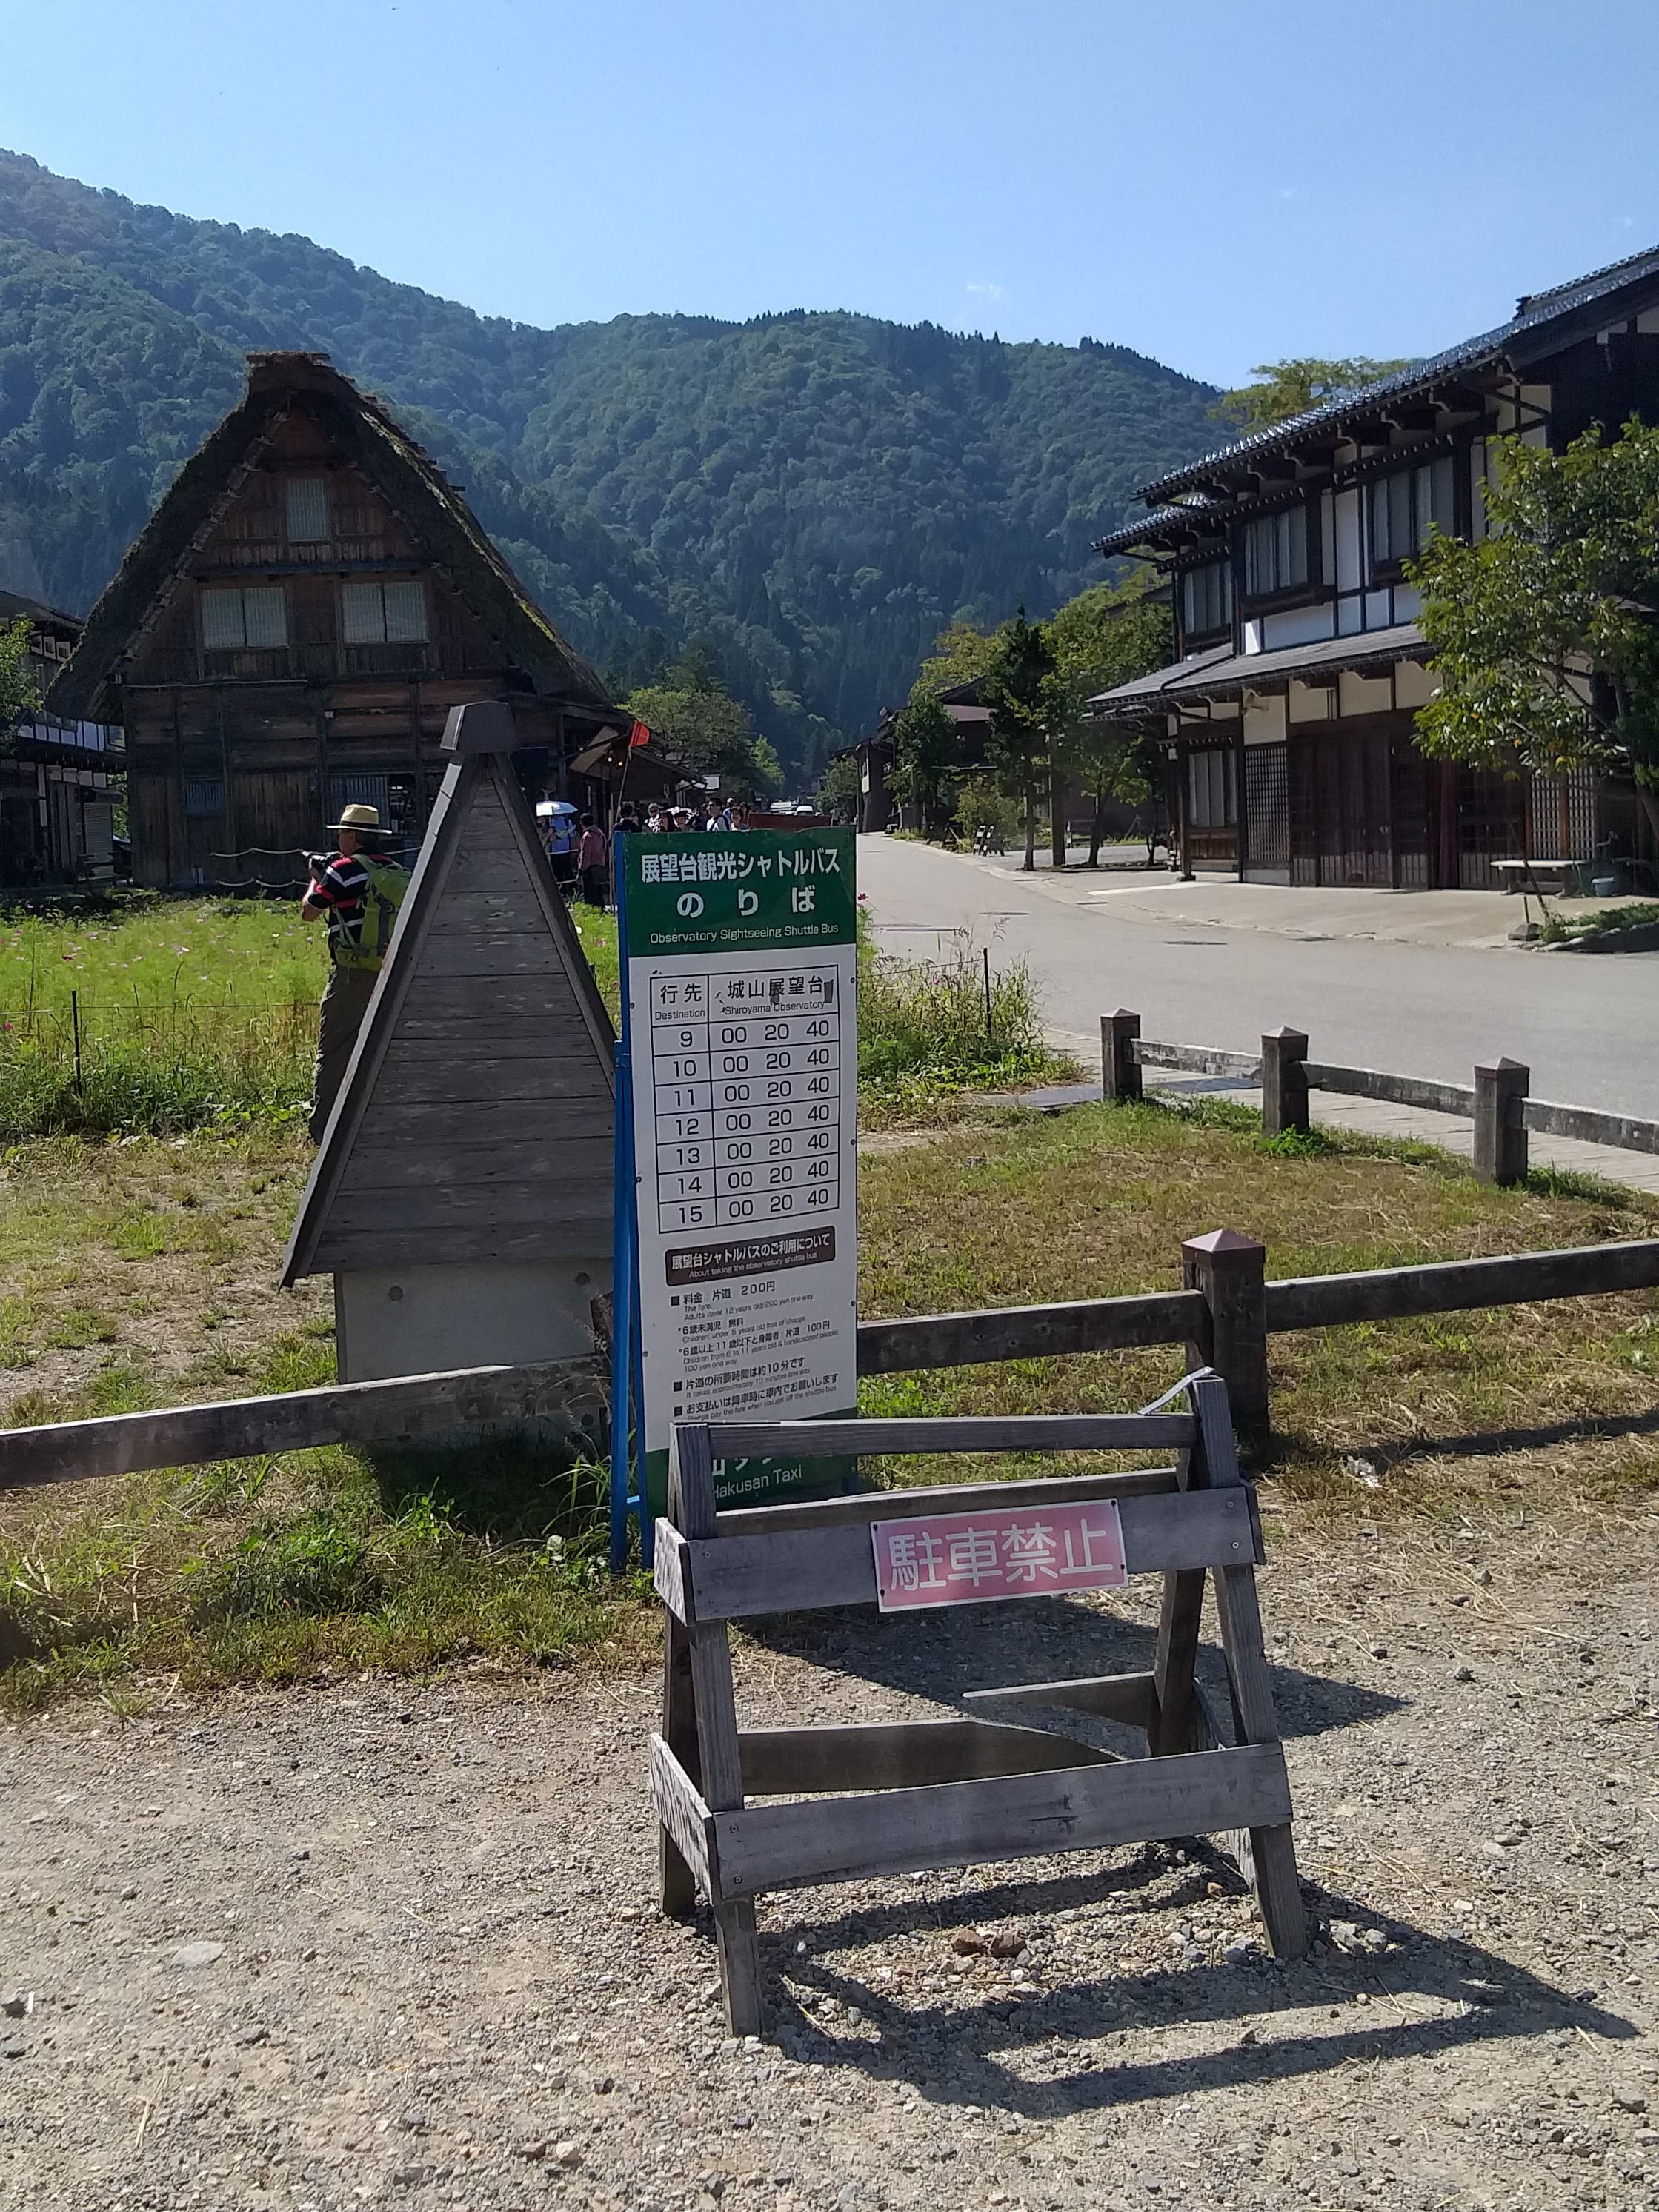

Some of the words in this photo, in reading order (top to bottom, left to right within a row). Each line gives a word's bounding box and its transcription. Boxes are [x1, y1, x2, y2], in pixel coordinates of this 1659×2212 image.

[642, 847, 840, 883] 展望台観光シャトルバス
[650, 931, 717, 943] Observatory
[720, 926, 782, 940] Sightseeing
[785, 924, 819, 937] Shuttle
[822, 923, 839, 934] Bus
[660, 983, 702, 1004] 行先
[728, 975, 822, 998] 城山展望台
[655, 1009, 705, 1020] Destination
[725, 1005, 771, 1014] Shiroyama
[774, 1001, 825, 1012] Observatory
[680, 1031, 693, 1047] 9
[722, 1026, 747, 1043] 00
[765, 1023, 789, 1040] 20
[806, 1020, 829, 1036] 40
[673, 1060, 696, 1077] 10
[723, 1055, 748, 1072] 00
[766, 1052, 791, 1069] 20
[807, 1049, 829, 1065] 40
[675, 1089, 694, 1106] 11
[725, 1084, 750, 1102] 00
[768, 1080, 791, 1098] 20
[807, 1077, 829, 1093] 40
[676, 1118, 699, 1136] 12
[726, 1113, 751, 1131] 00
[768, 1109, 792, 1126] 20
[807, 1104, 829, 1121] 40
[676, 1147, 700, 1165] 13
[727, 1142, 752, 1160] 00
[769, 1137, 792, 1155] 20
[808, 1132, 829, 1149] 40
[677, 1177, 702, 1195] 14
[728, 1171, 753, 1189] 00
[769, 1166, 792, 1183] 20
[807, 1160, 829, 1178] 40
[679, 1206, 702, 1223] 15
[729, 1200, 753, 1218] 00
[770, 1195, 792, 1212] 20
[807, 1189, 828, 1205] 40
[672, 1233, 831, 1269] 展望台シャトルバスのご利用について
[689, 1269, 710, 1278] About
[711, 1266, 732, 1275] taking
[746, 1258, 783, 1269] observatory
[785, 1255, 805, 1263] shuttle
[683, 1292, 703, 1305] 料金
[712, 1288, 731, 1301] 片道
[741, 1281, 775, 1295] 200円
[684, 1312, 705, 1321] Adults
[735, 1305, 752, 1313] years
[808, 1320, 830, 1332] 100円
[685, 1364, 698, 1372] 100
[773, 1464, 802, 1484] Taxi
[889, 1518, 1114, 1591] 駐車禁止
